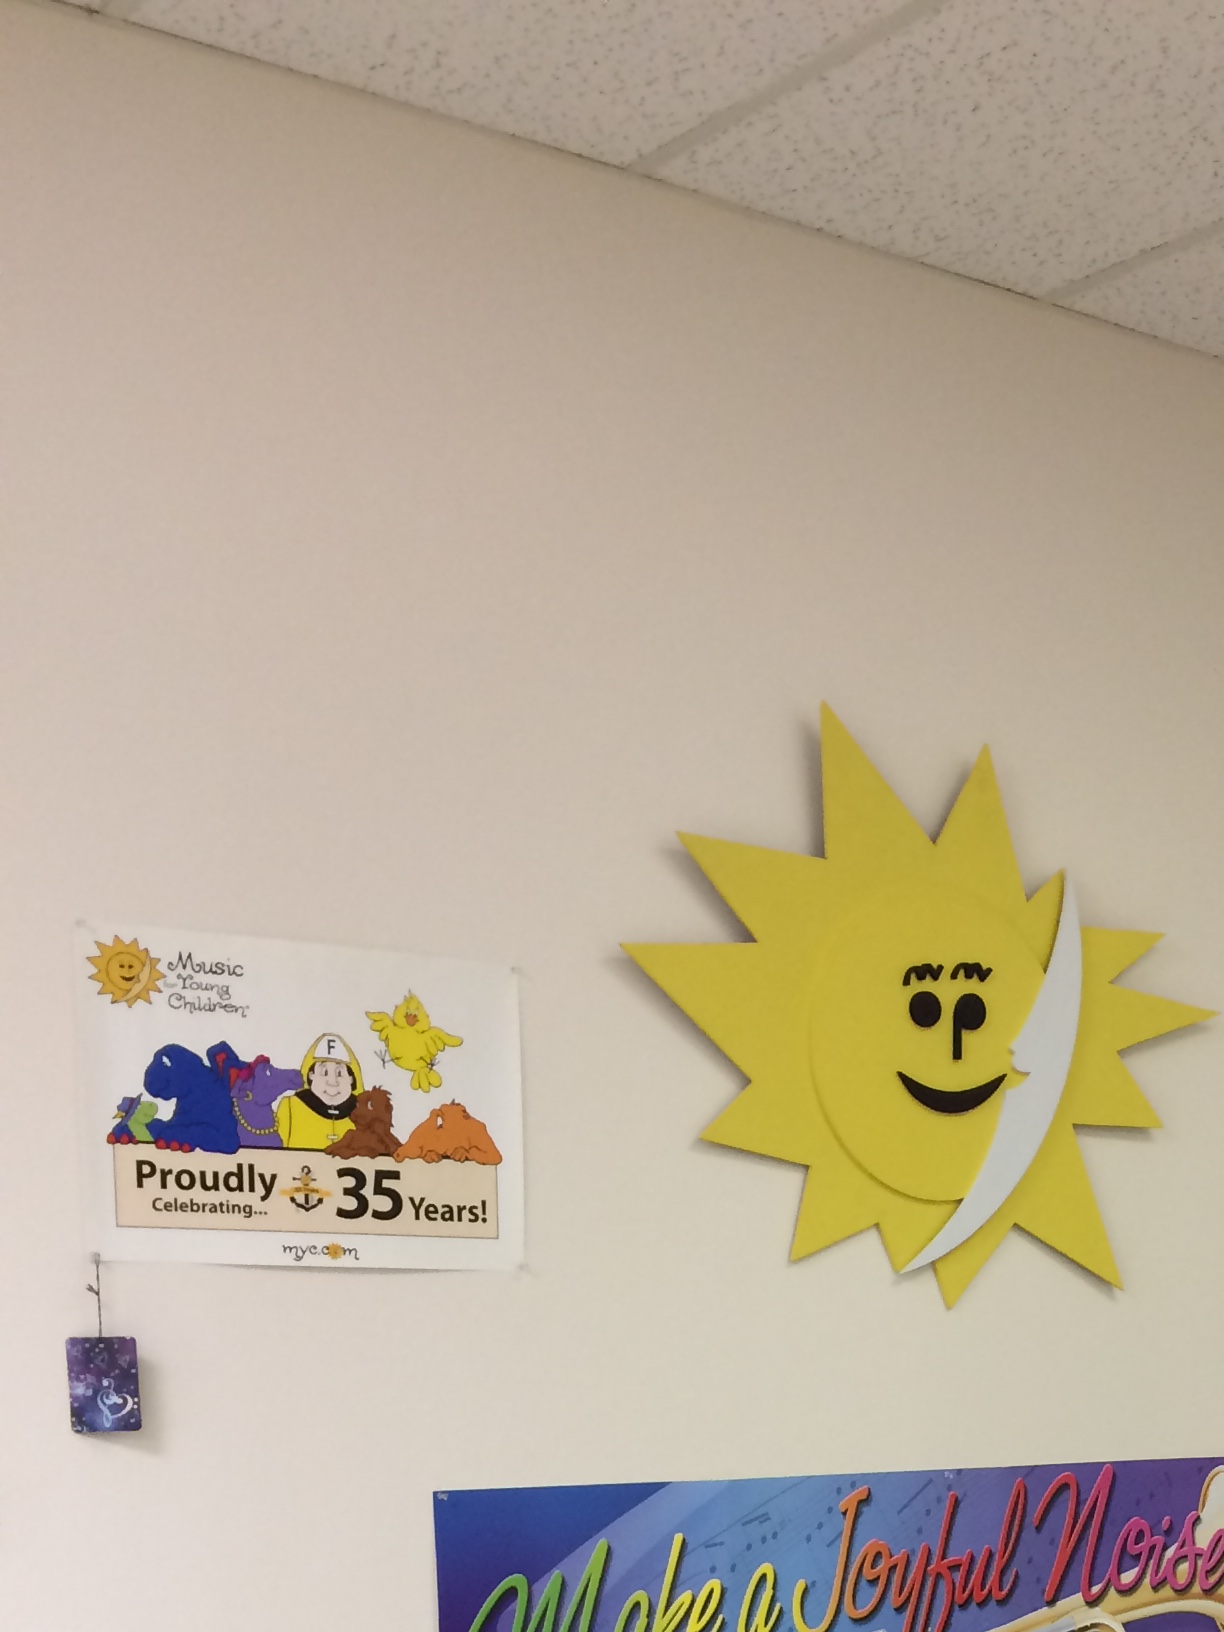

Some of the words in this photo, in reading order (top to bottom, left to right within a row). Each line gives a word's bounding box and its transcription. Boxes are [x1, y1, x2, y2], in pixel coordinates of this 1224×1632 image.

[167, 951, 244, 977] Music
[177, 973, 232, 1001] Young
[326, 1039, 336, 1055] F
[135, 1160, 278, 1201] Proudly
[151, 1197, 268, 1219] Celebrating...
[335, 1167, 401, 1221] 35
[408, 1197, 488, 1224] Years!
